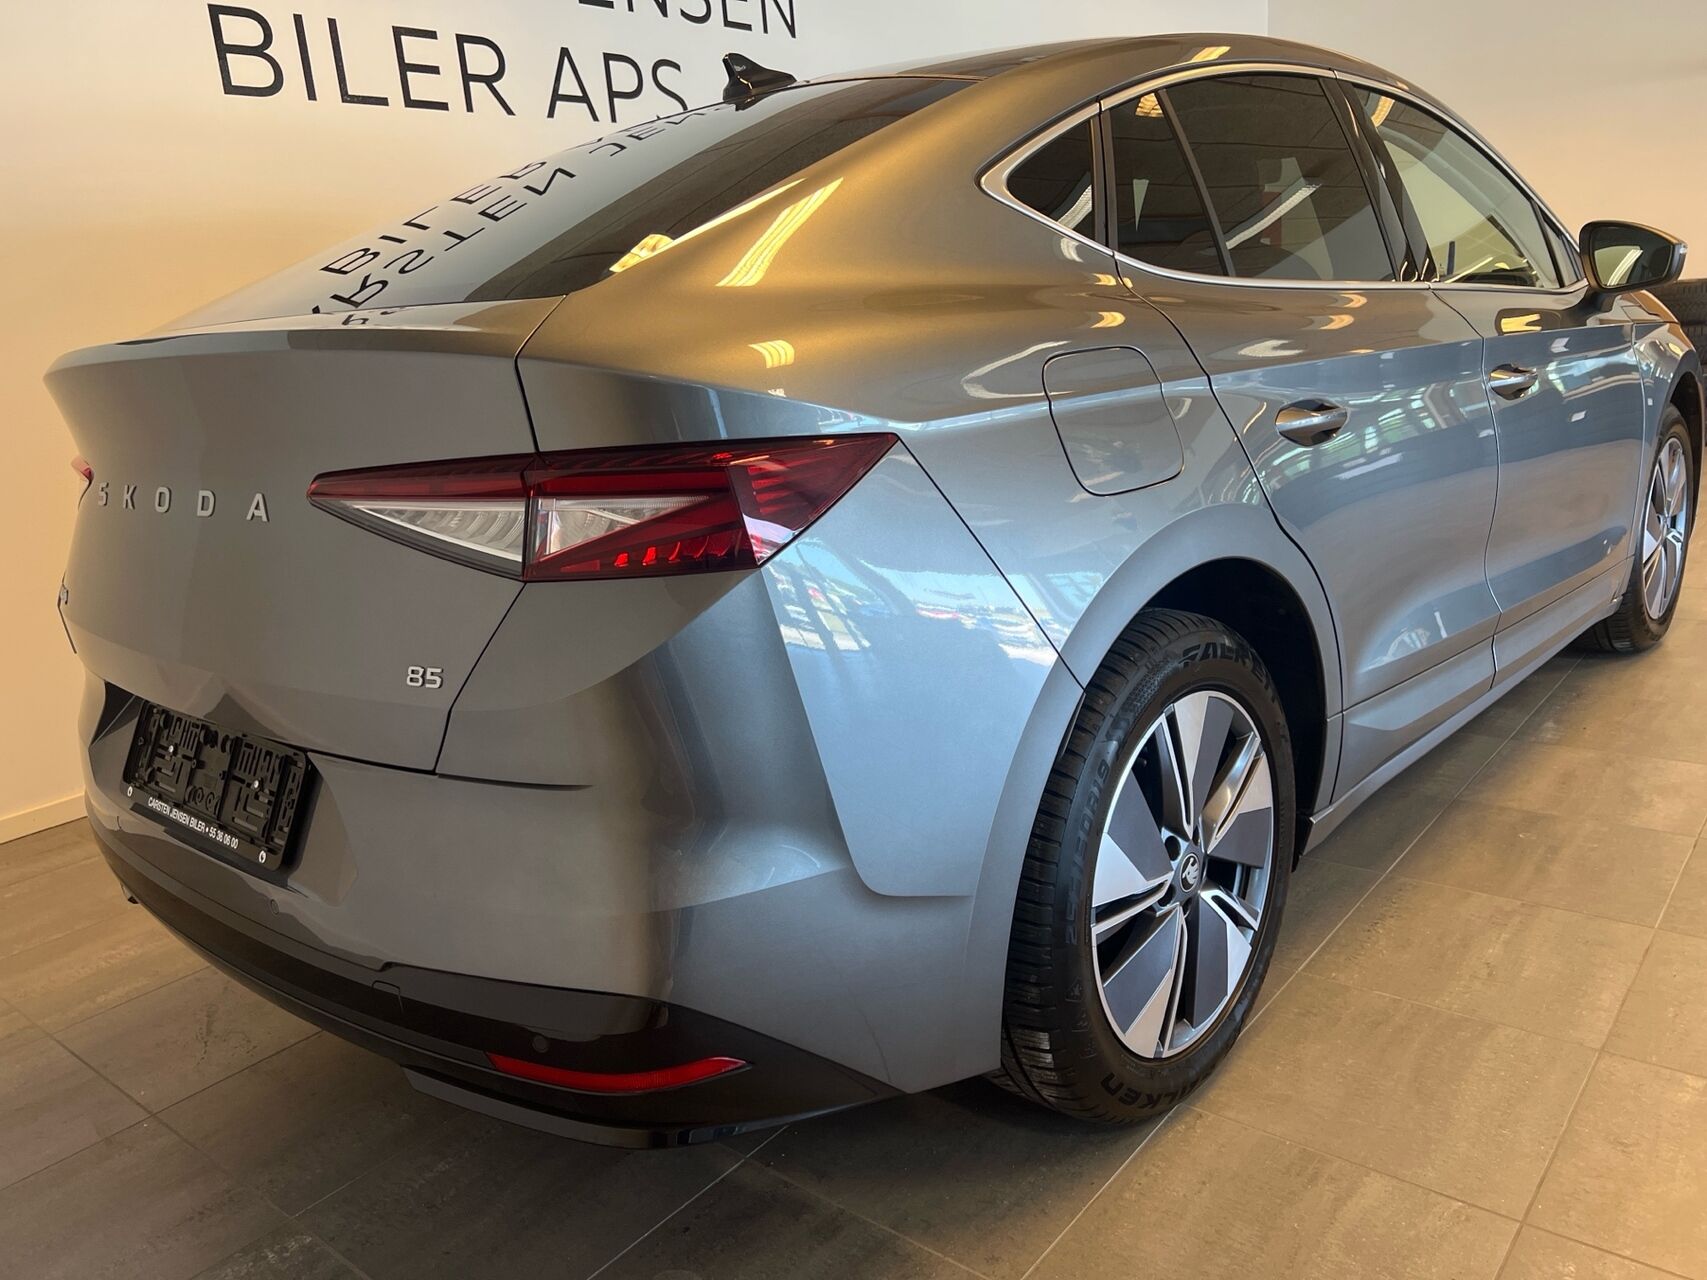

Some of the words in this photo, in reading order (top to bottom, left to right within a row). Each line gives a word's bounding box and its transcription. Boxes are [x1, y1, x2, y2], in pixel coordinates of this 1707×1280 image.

[578, 0, 797, 39] SEN
[207, 4, 516, 116] BILER
[546, 47, 688, 123] APS
[98, 482, 269, 522] SKODA
[406, 665, 443, 689] 85
[148, 797, 170, 816] CARSTEN
[170, 806, 189, 824] JENSEN
[189, 816, 206, 832] BILER
[208, 826, 216, 839] 55
[216, 830, 224, 843] 36
[230, 837, 239, 849] 00
[1100, 1072, 1200, 1111] LKEN
